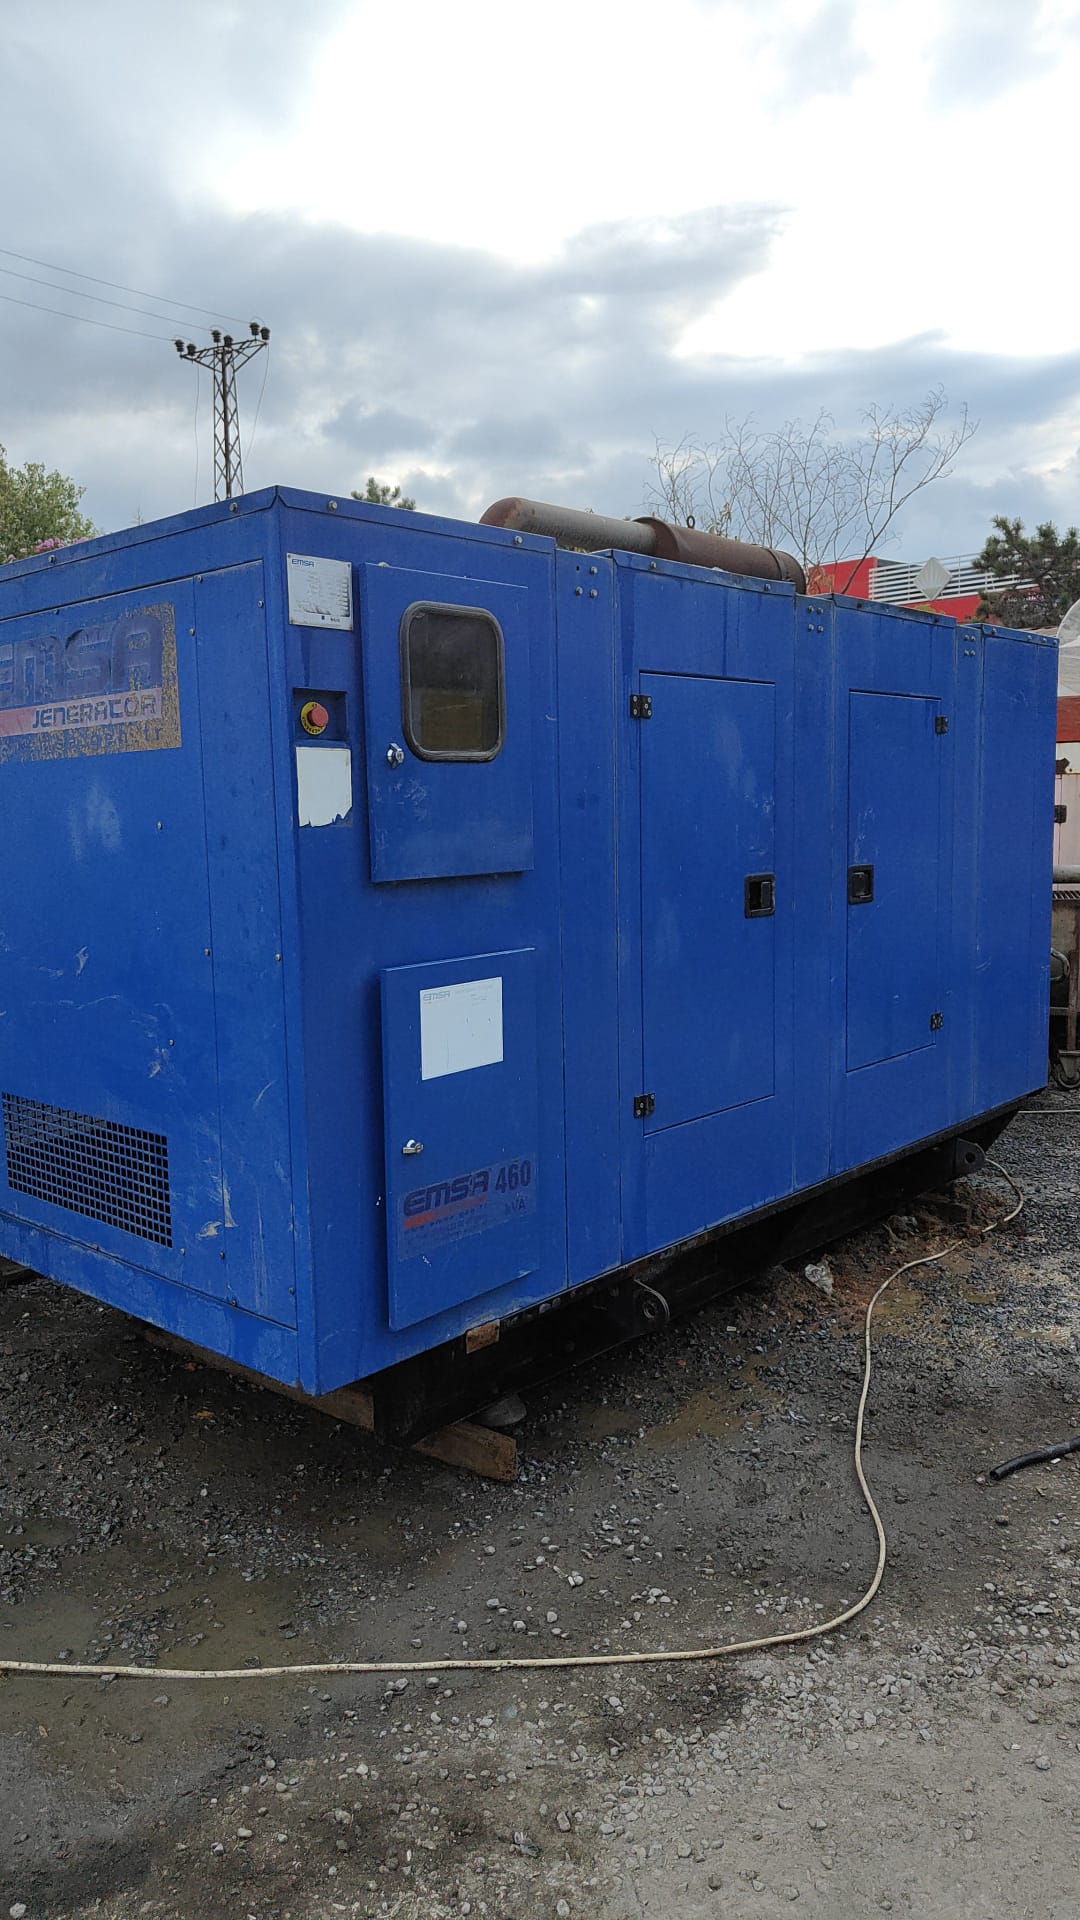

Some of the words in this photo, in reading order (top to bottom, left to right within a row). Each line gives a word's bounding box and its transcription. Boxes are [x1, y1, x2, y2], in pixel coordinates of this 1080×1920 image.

[291, 558, 315, 568] EMSA
[423, 989, 451, 1001] EMSA
[403, 1170, 490, 1217] EMSA
[495, 1159, 532, 1194] 460
